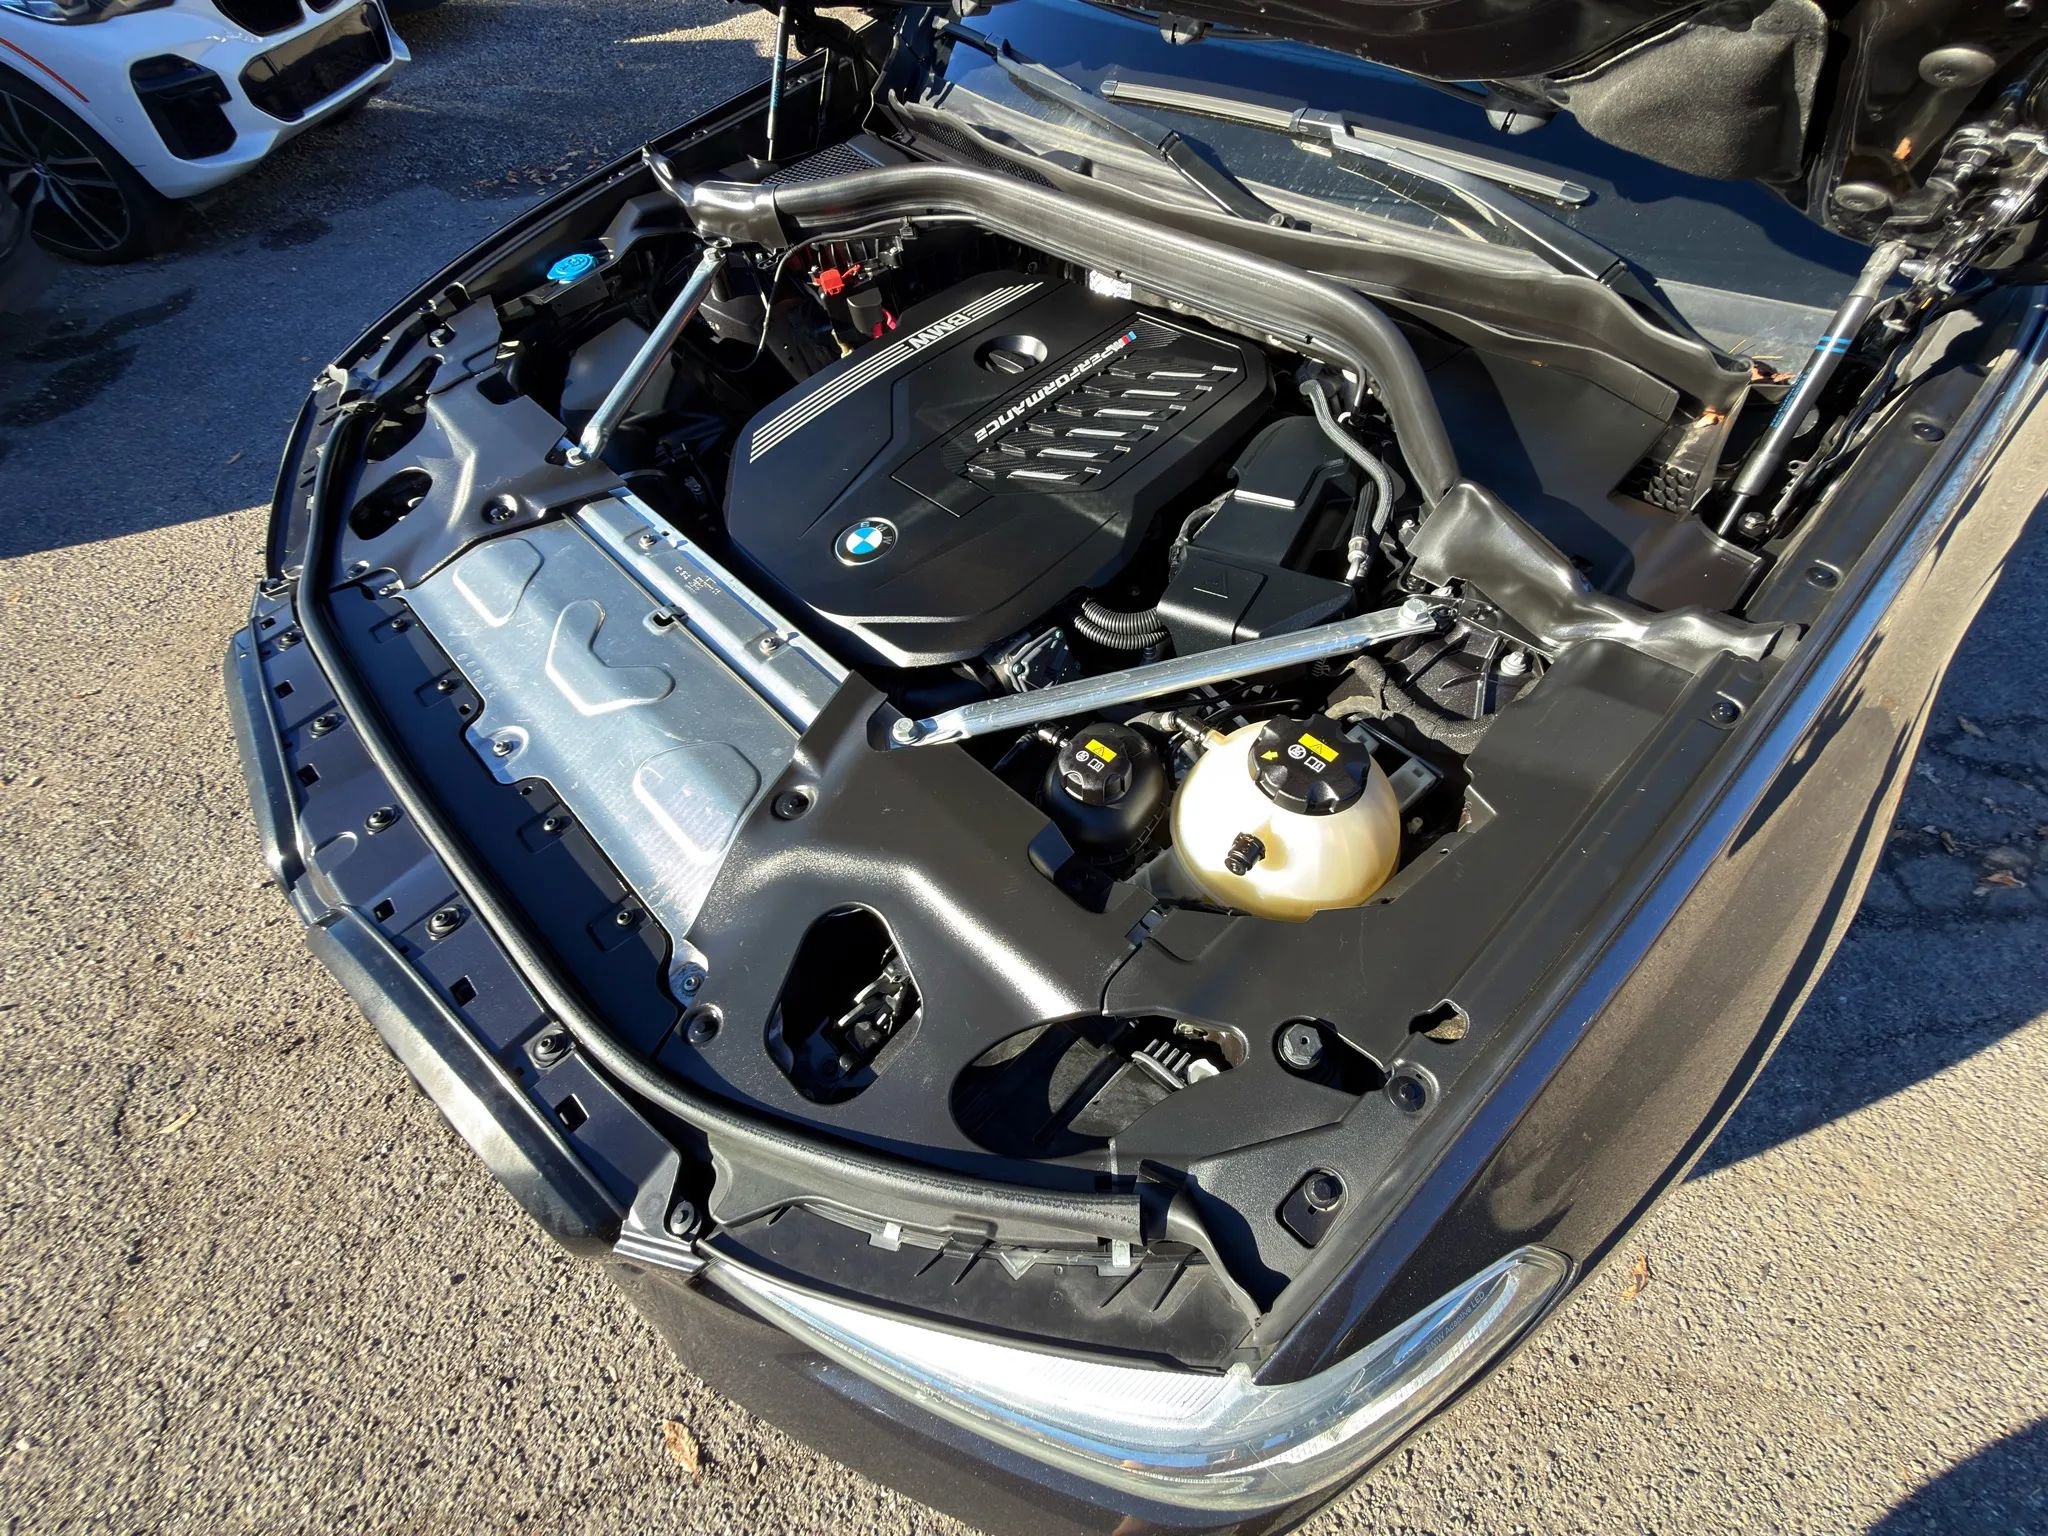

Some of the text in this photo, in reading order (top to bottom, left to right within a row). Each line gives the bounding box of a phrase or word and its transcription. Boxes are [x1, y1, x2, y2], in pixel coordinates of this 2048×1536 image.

[908, 313, 972, 350] BMW
[860, 521, 893, 545] BMW
[1425, 1291, 1485, 1354] BMW Adaptive LED
